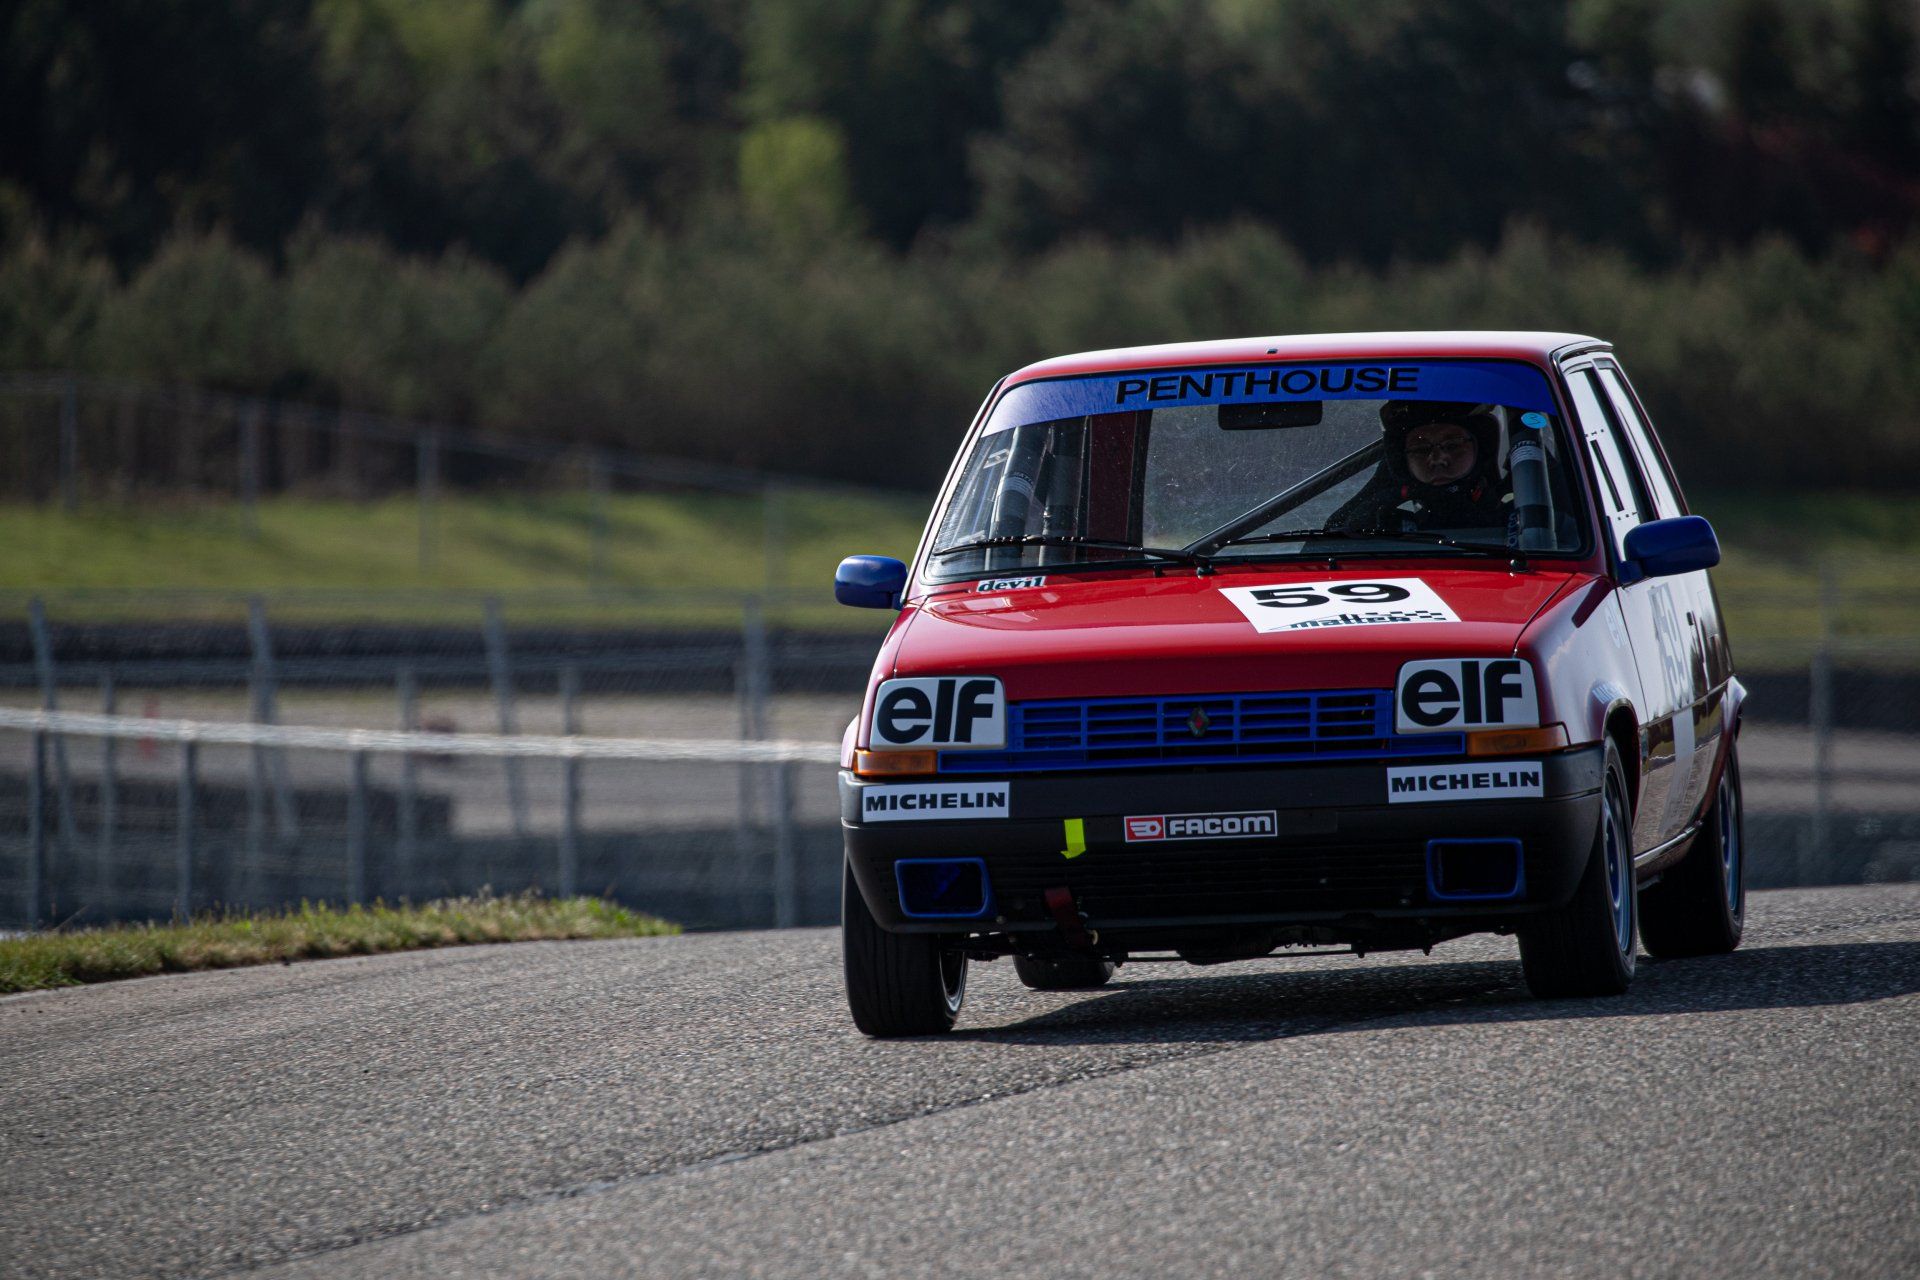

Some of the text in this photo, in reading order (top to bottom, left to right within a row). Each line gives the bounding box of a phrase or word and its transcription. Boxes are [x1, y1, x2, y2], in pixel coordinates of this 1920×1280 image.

[1116, 368, 1420, 404] PENTHOUSE
[978, 576, 1043, 592] devil
[1250, 584, 1410, 608] 59
[1402, 660, 1523, 727] elf
[877, 679, 996, 744] elf
[1391, 771, 1540, 793] MICHELIN
[865, 792, 1006, 812] MICHELIN
[1169, 816, 1272, 836] FACOM
